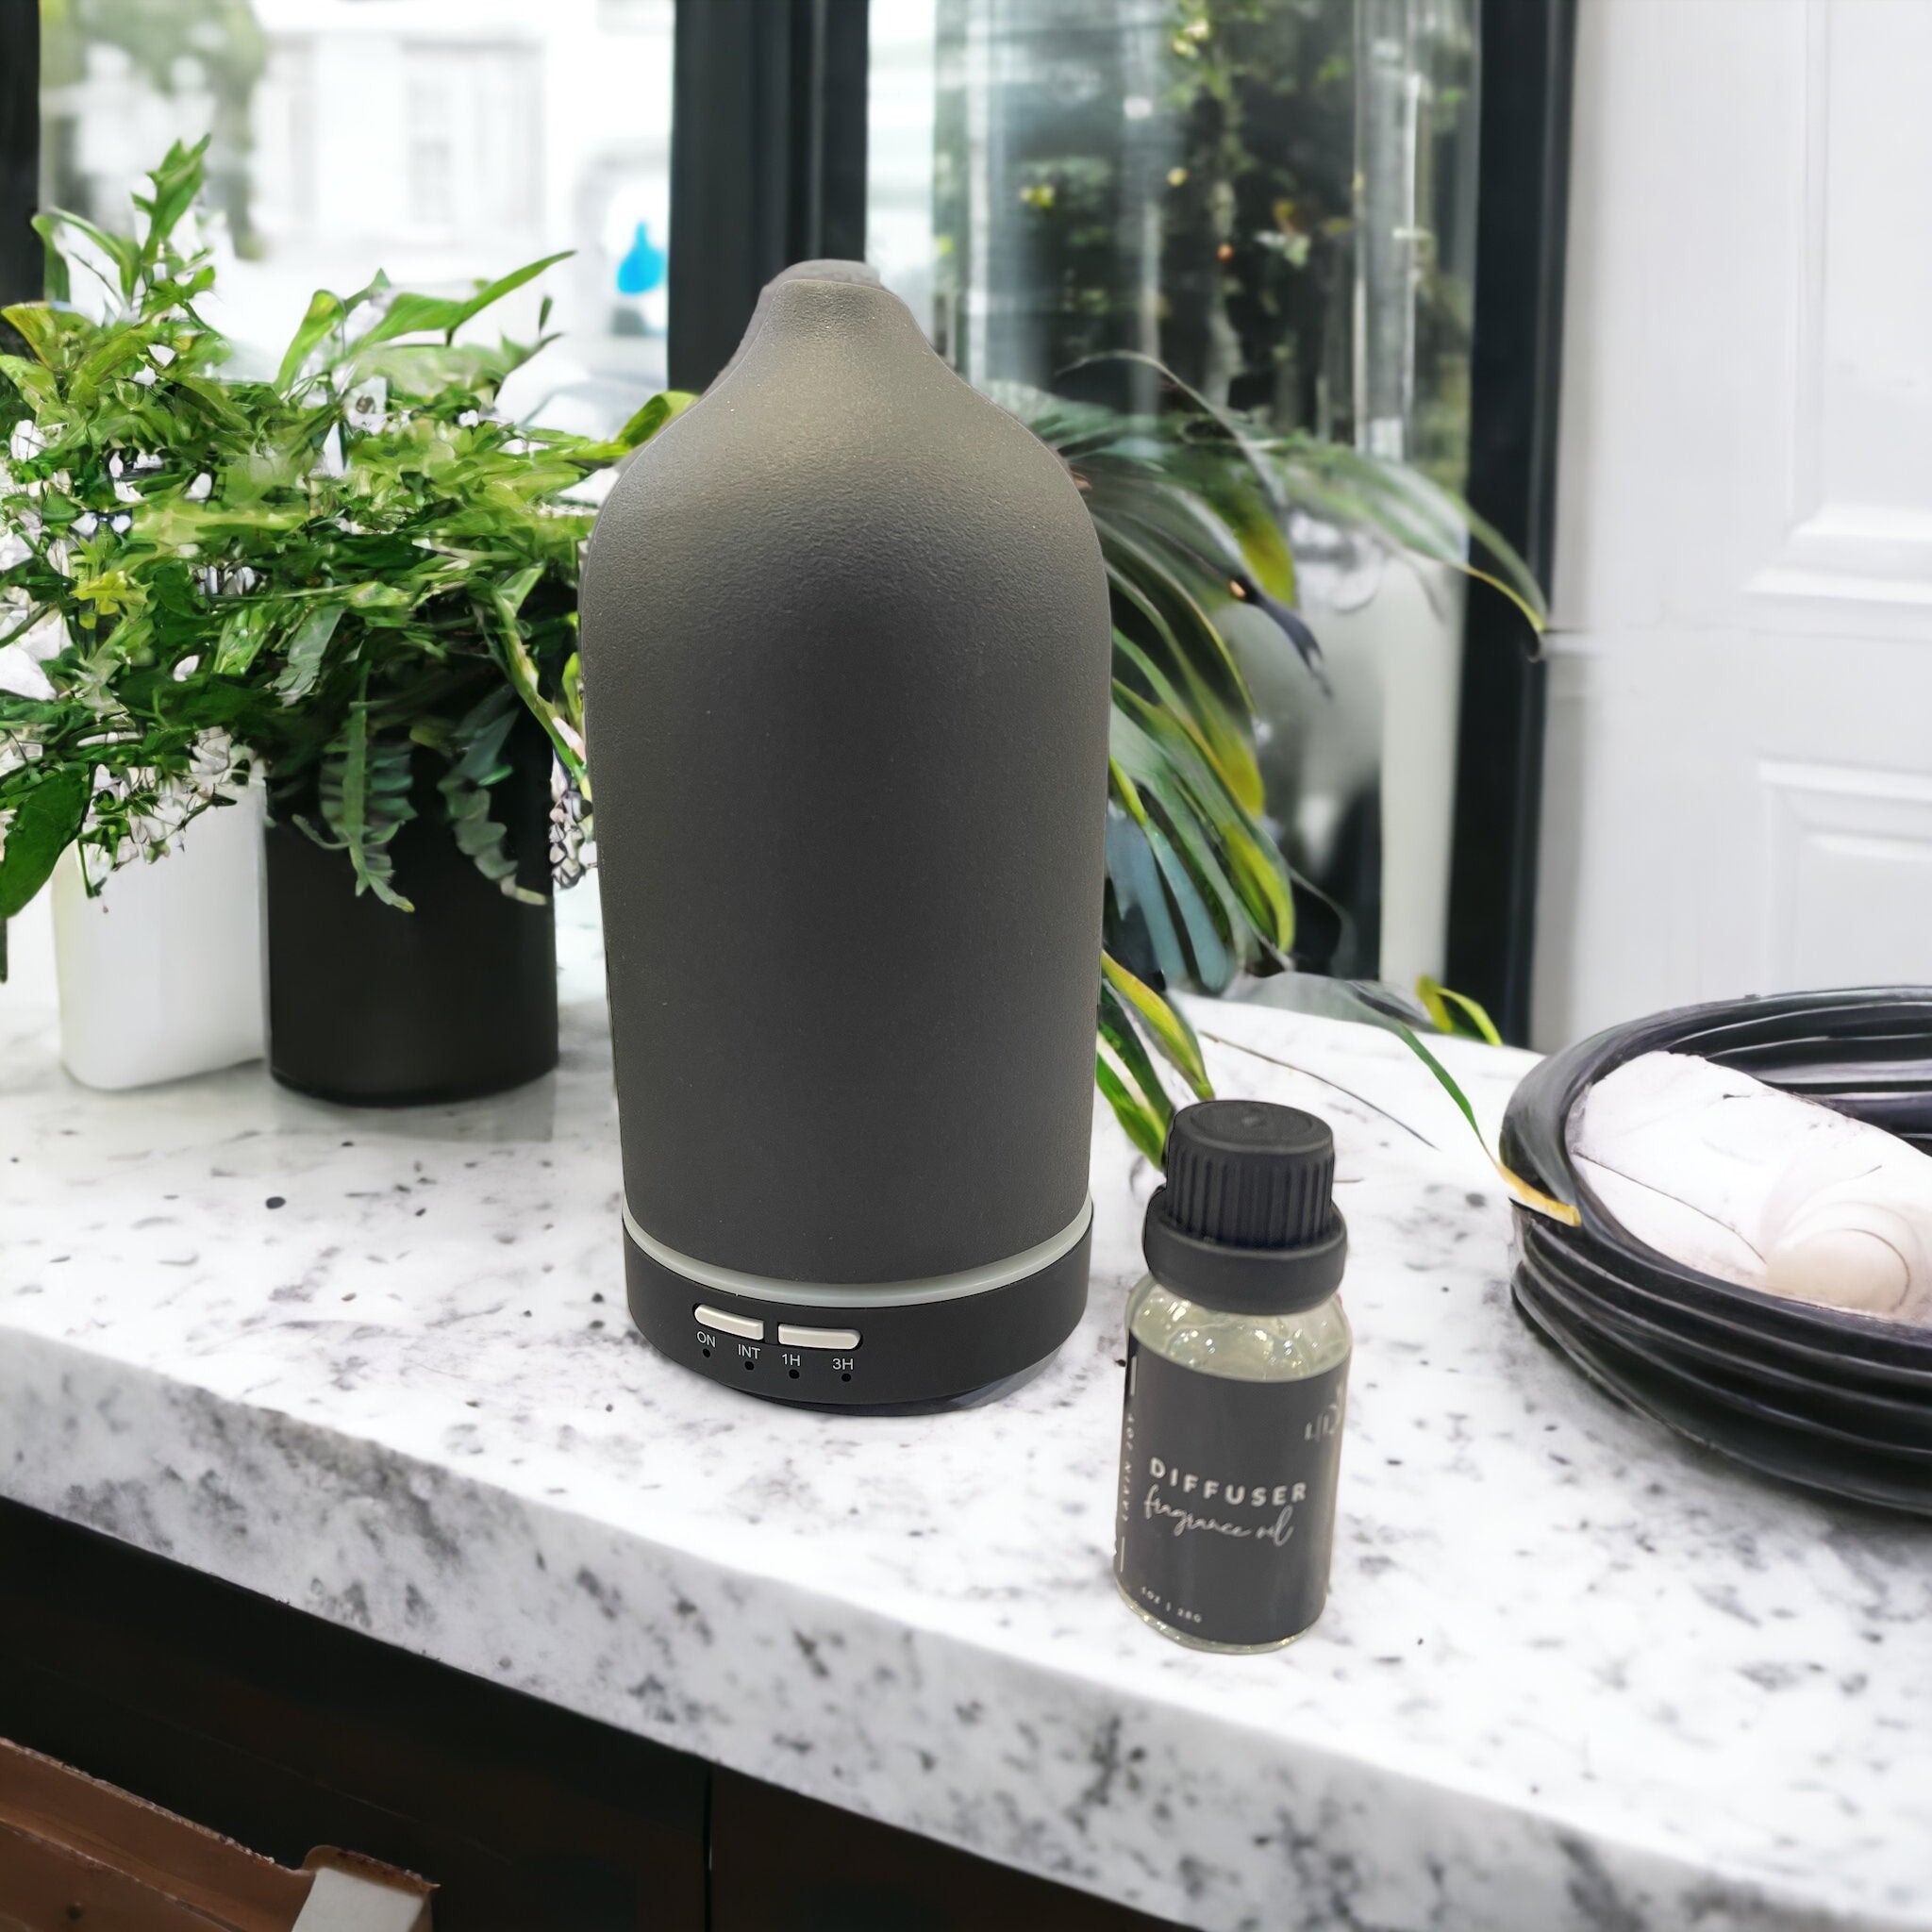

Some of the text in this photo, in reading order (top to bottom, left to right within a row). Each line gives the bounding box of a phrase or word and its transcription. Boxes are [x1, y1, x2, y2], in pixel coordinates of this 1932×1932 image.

[696, 1331, 716, 1348] ON
[738, 1344, 761, 1359] INT
[782, 1354, 801, 1367] 1H
[832, 1358, 854, 1370] 3H
[1149, 1457, 1307, 1507] DIFFUSER
[1143, 1484, 1294, 1547] fragrance oil
